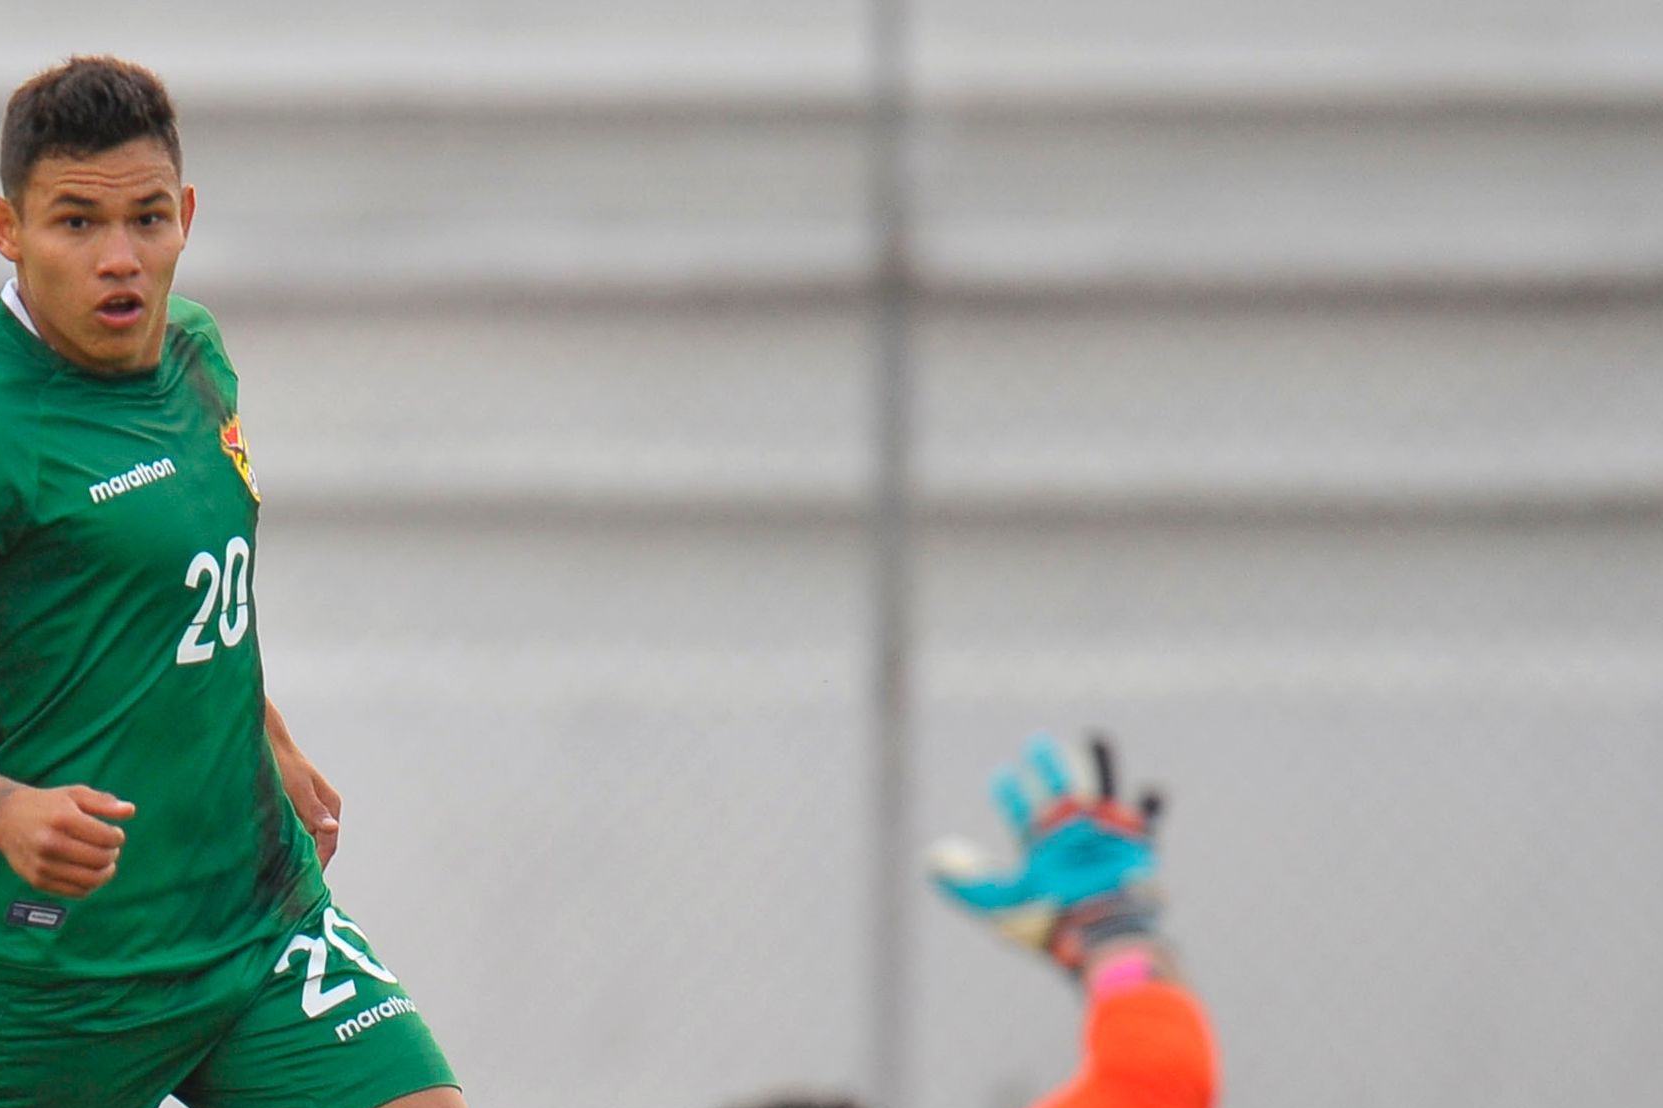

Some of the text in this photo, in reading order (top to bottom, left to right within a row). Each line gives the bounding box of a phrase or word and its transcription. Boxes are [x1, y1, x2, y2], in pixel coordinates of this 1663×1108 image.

[88, 457, 177, 504] marathon
[176, 536, 250, 665] 20
[273, 907, 398, 1019] 20
[335, 995, 417, 1043] maratho
